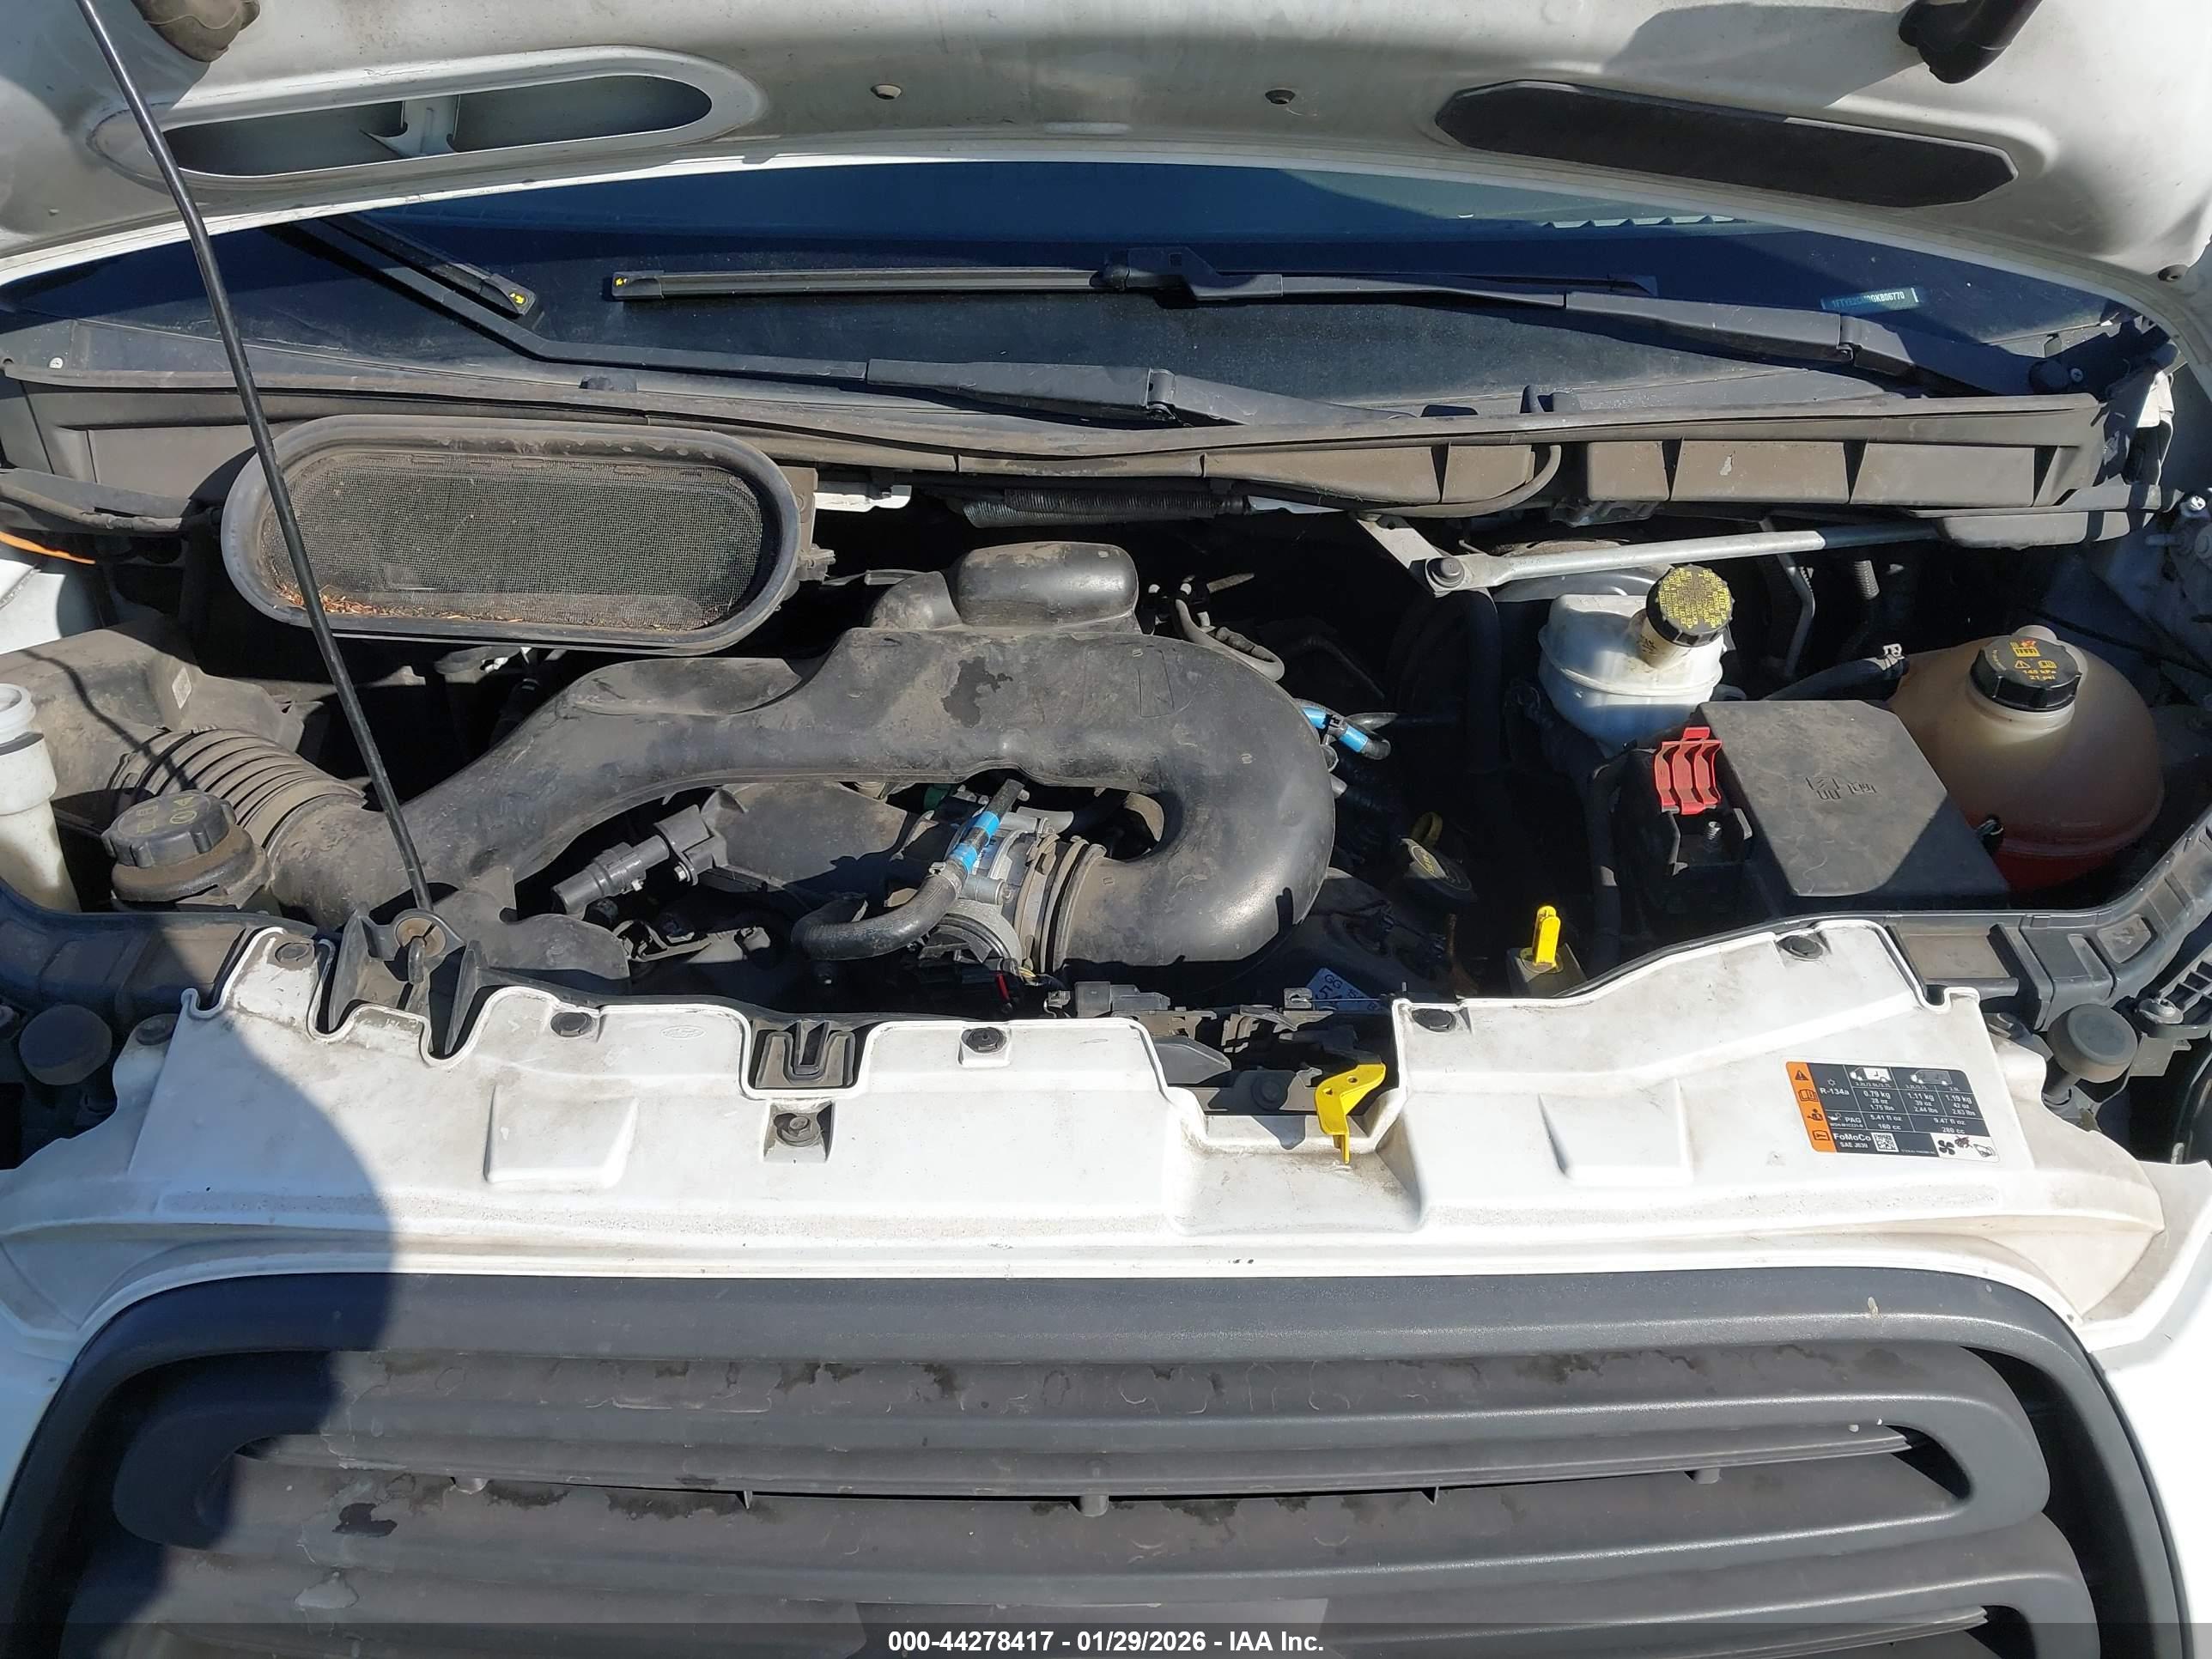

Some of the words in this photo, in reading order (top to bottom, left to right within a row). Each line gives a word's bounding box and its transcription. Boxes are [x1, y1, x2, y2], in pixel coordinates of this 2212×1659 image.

[1324, 974, 1343, 988] GG
[1820, 1087, 1850, 1096] R-134a
[1881, 1091, 1891, 1099] kg
[1923, 1092, 1935, 1102] kg
[1961, 1096, 1972, 1104] kg
[1833, 1133, 1871, 1142] FoMoCo
